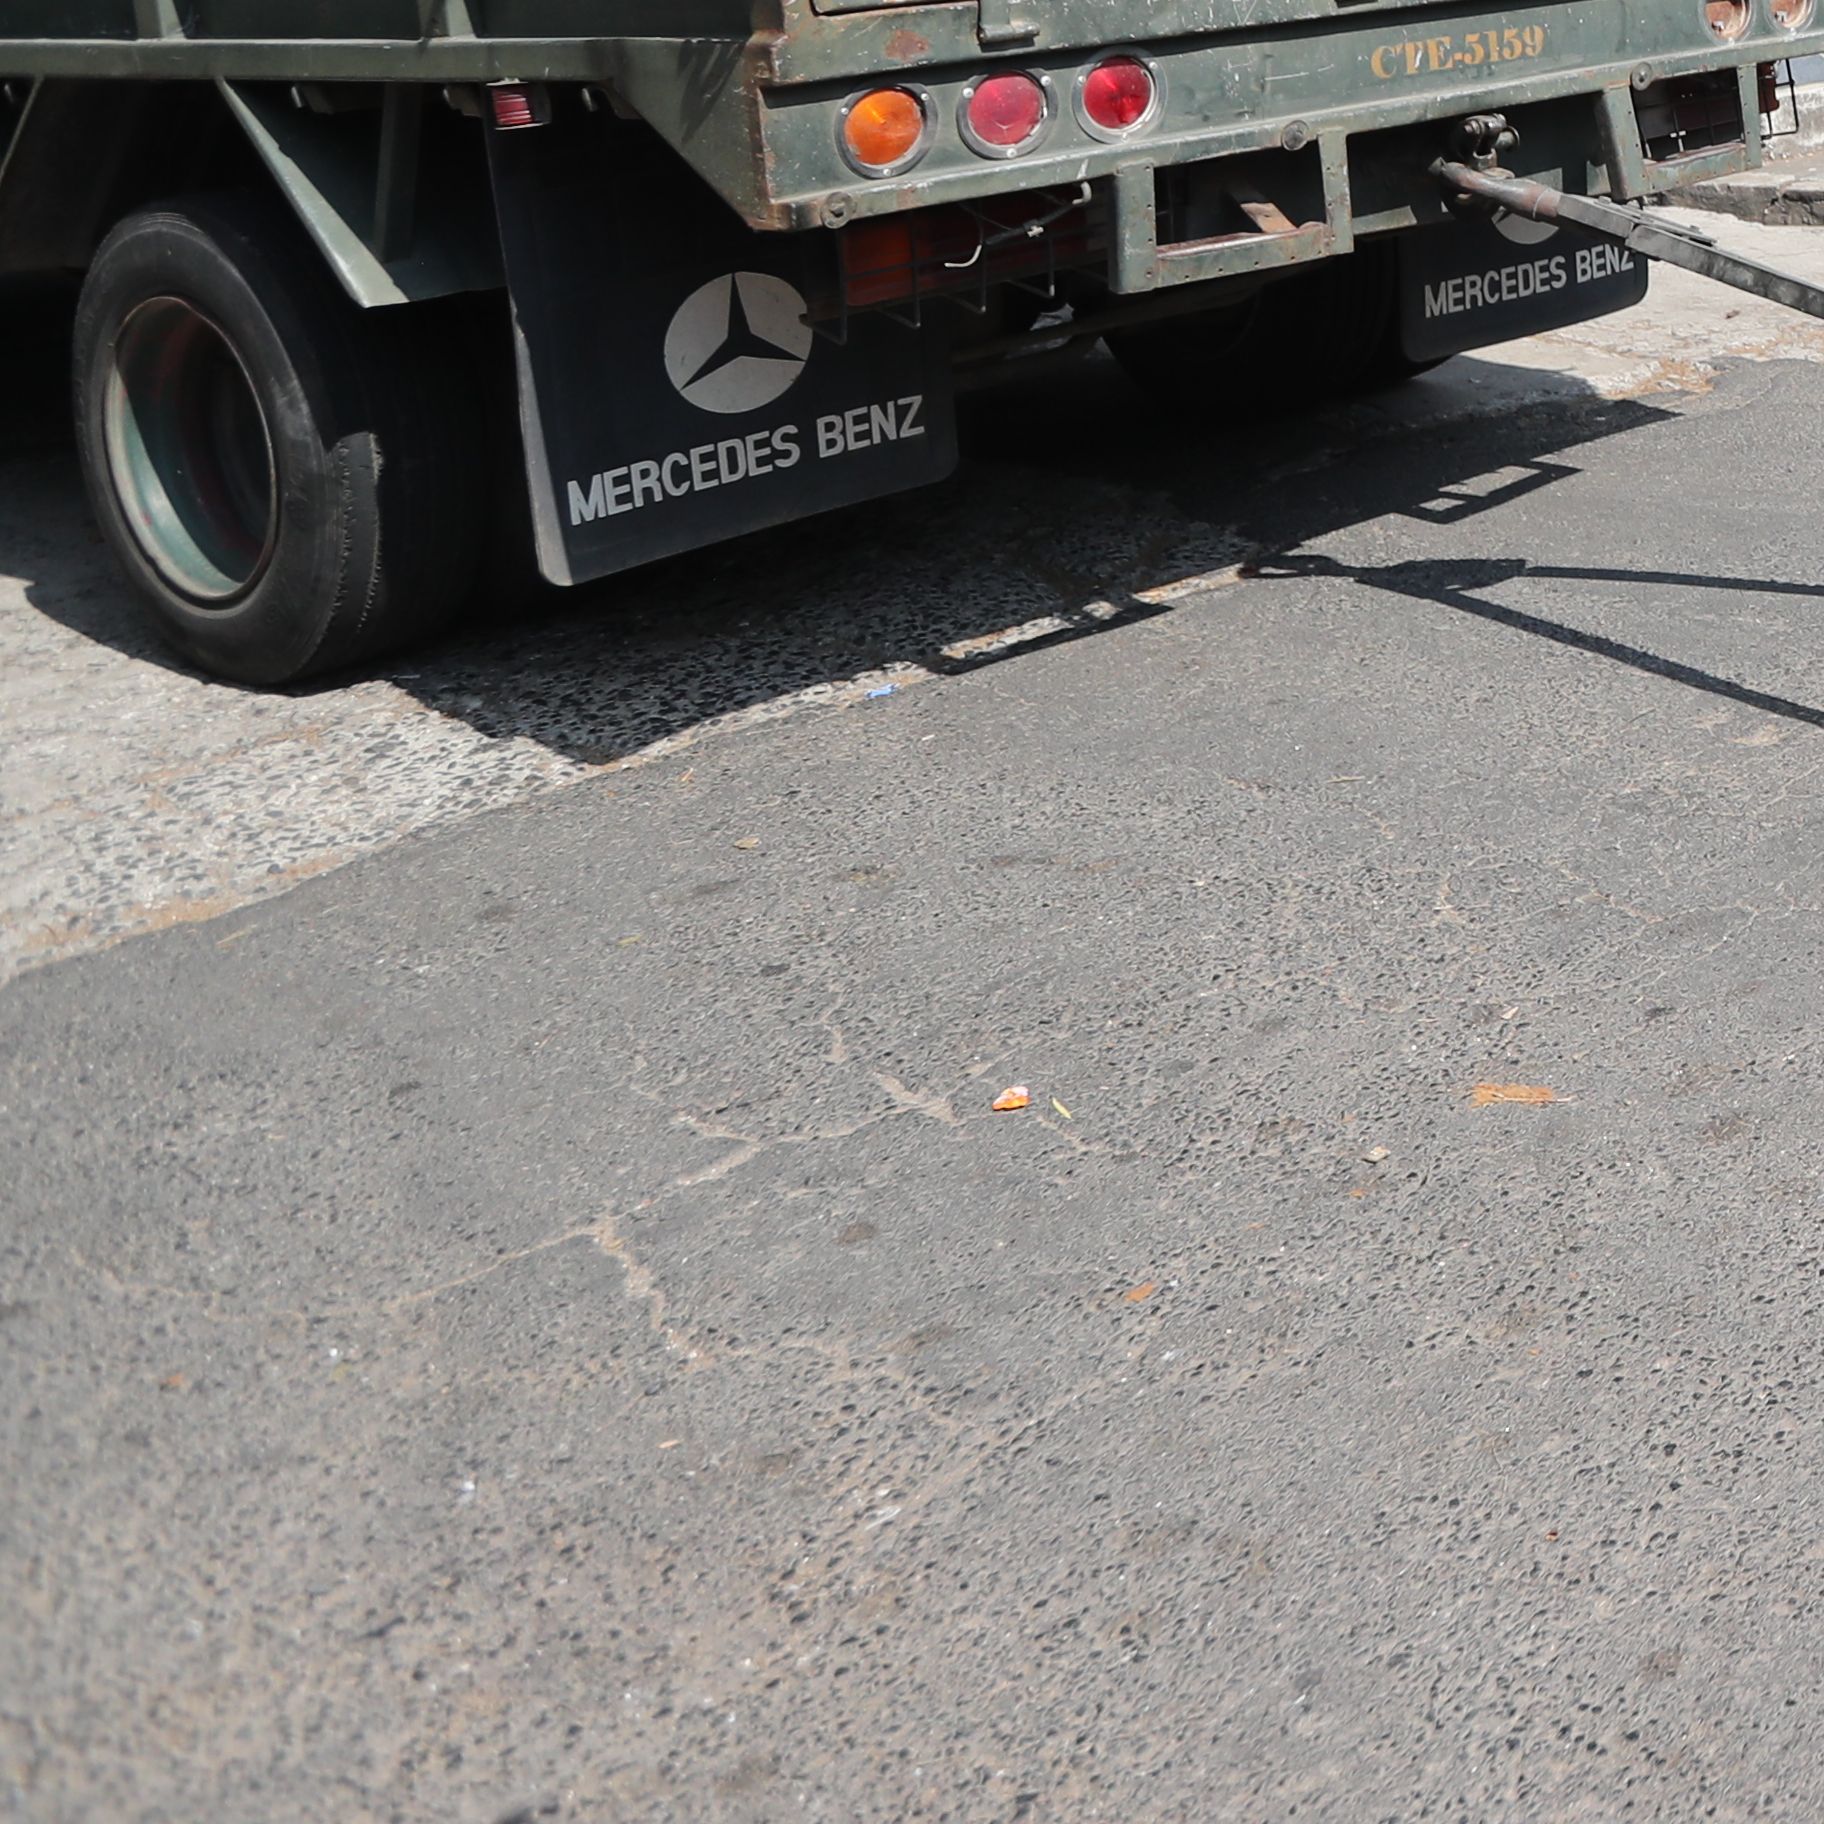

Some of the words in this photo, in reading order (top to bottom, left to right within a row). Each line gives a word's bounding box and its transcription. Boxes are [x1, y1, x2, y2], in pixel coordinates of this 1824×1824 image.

[1370, 25, 1545, 79] CTE-5159
[1424, 255, 1567, 318] MERCEDES
[1575, 243, 1634, 284] BENZ
[567, 424, 801, 526] MERCEDES
[816, 394, 925, 458] BENZ
